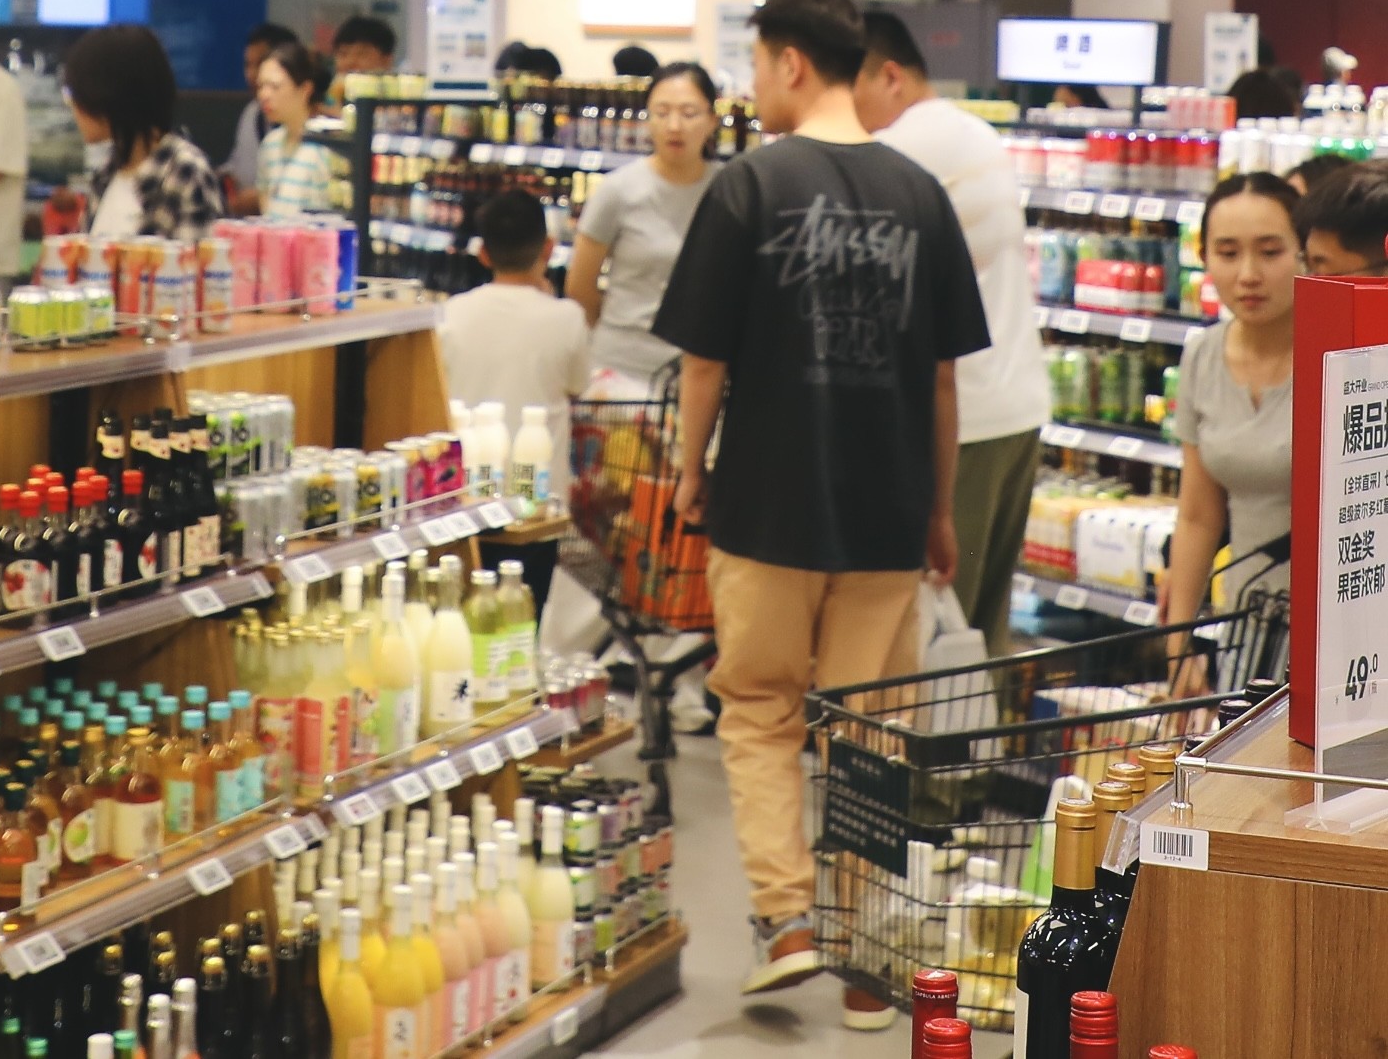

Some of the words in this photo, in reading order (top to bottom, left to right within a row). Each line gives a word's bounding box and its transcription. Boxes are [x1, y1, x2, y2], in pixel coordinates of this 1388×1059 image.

[1343, 379, 1367, 395] 盛大开业
[1342, 399, 1388, 456] 爆品
[1337, 530, 1375, 566] 双金奖
[1337, 563, 1386, 604] 果香浓郁
